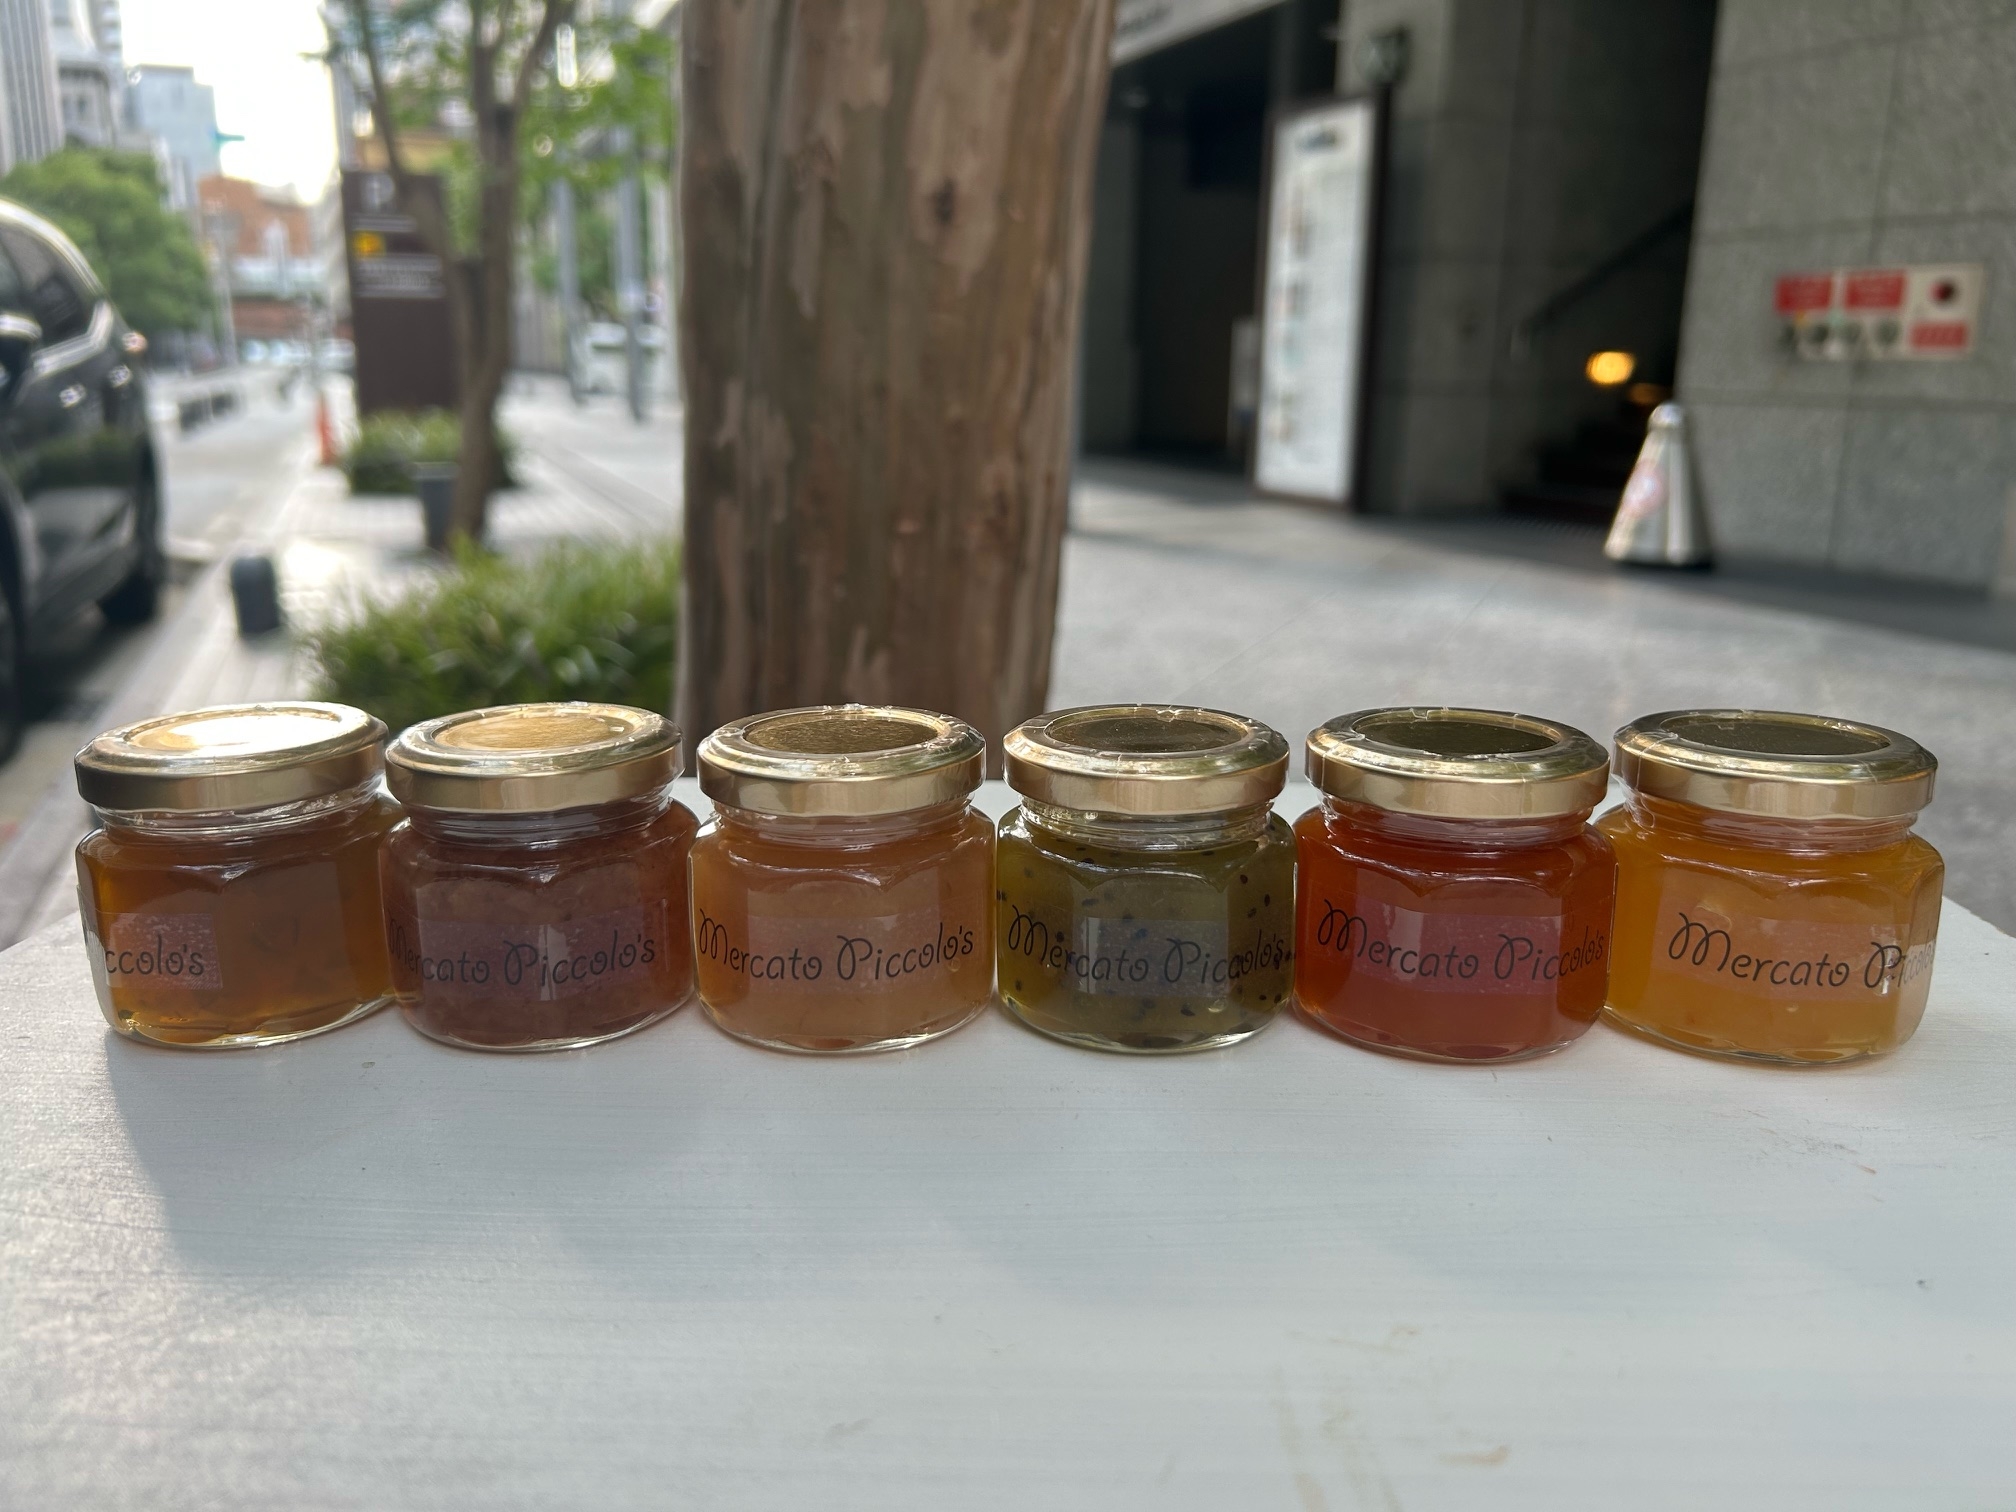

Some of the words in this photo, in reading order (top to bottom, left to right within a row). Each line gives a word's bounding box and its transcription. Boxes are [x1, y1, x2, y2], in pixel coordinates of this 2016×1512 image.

[104, 933, 205, 976] ccolo's
[387, 908, 490, 984] Mercato
[503, 930, 656, 986] Piccolo's
[699, 908, 822, 980] Mercato
[836, 923, 974, 981] Piccolo's
[1009, 904, 1149, 982] Mercato
[1164, 929, 1284, 984] Piccolo's
[1317, 900, 1479, 979] Mercato
[1493, 926, 1605, 980] Piccolo's
[1668, 912, 1849, 987] Mercato
